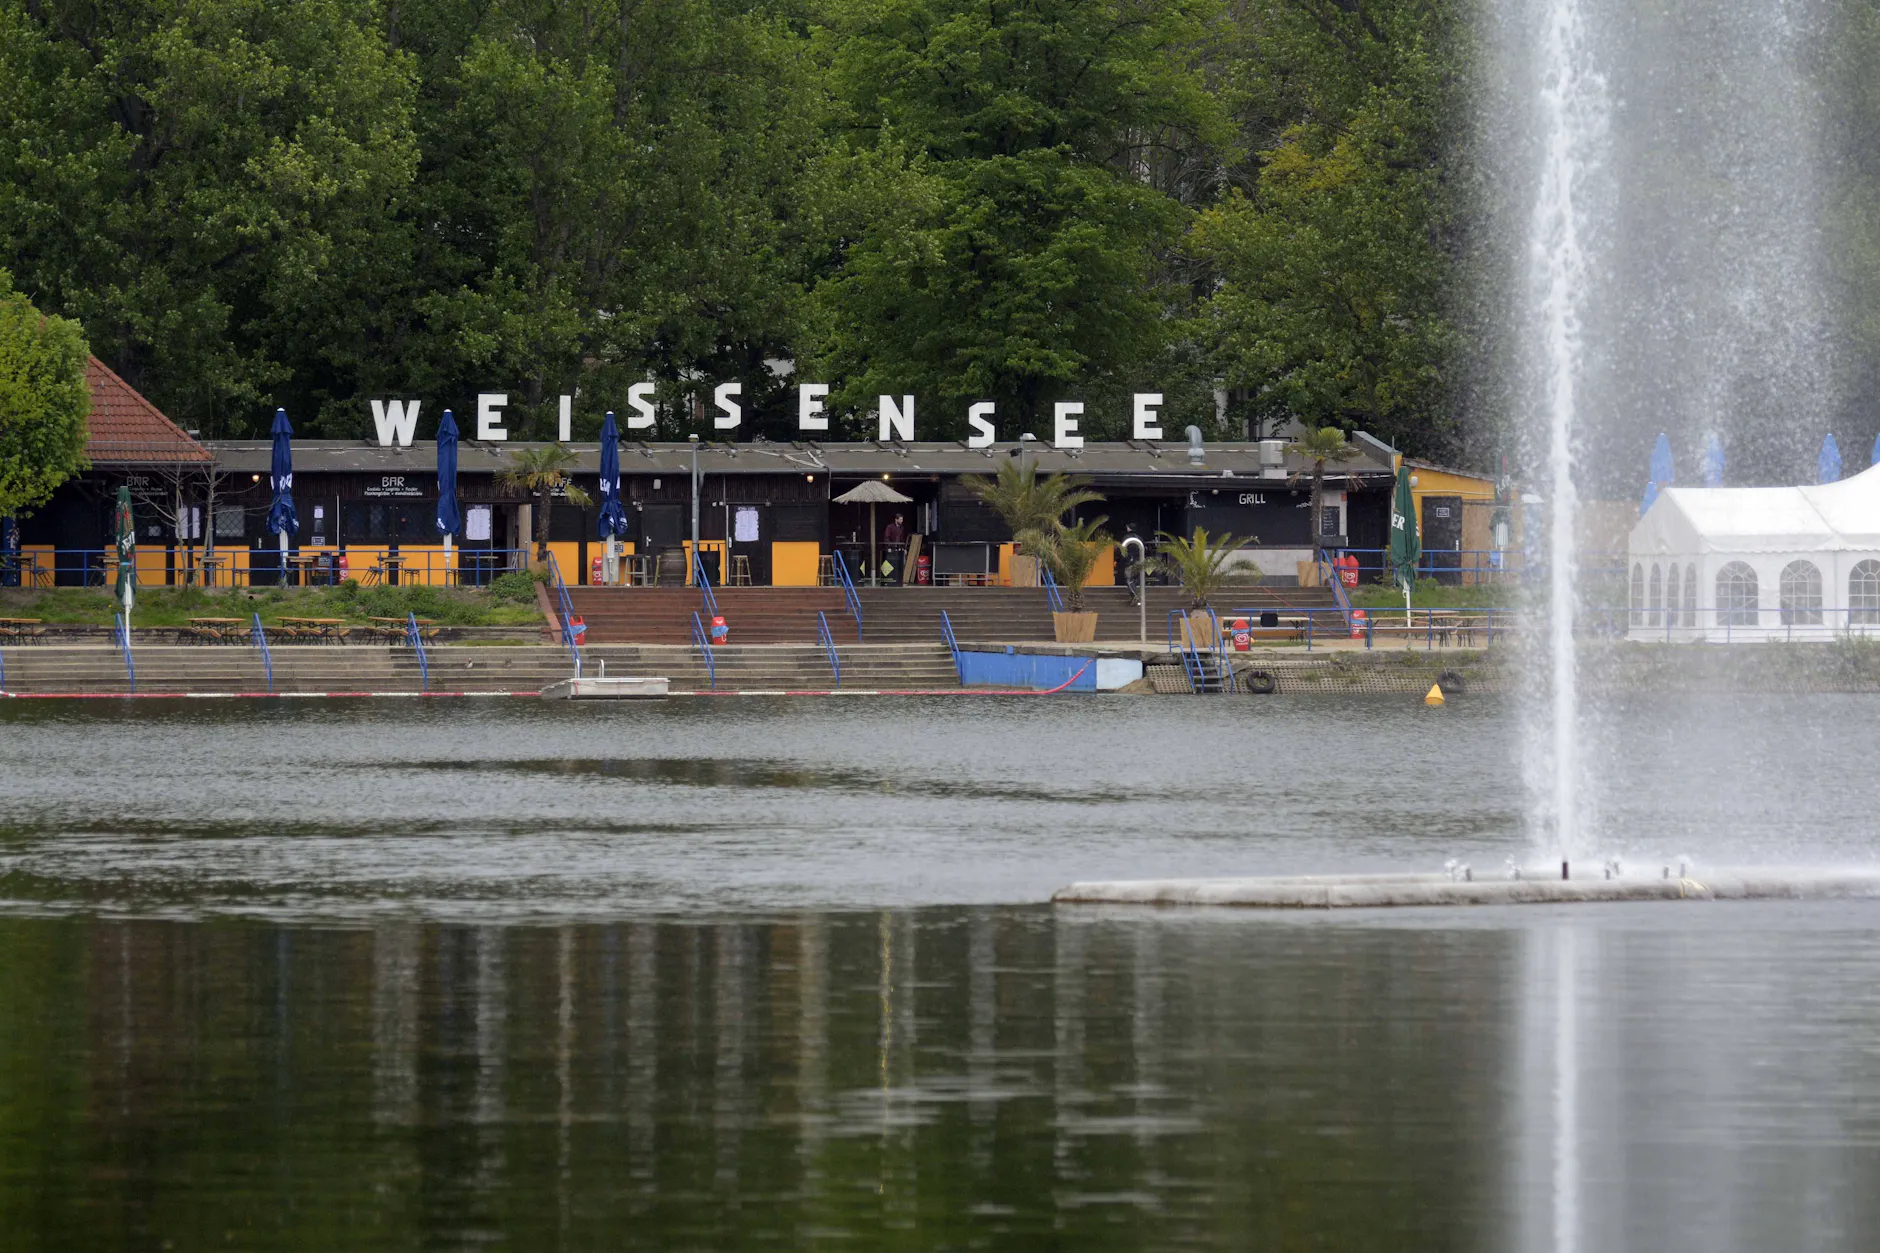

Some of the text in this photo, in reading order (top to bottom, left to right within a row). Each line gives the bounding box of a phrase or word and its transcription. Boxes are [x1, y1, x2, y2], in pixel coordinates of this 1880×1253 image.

[370, 382, 1163, 449] WEISSENSEE
[126, 476, 150, 487] BAR
[381, 476, 405, 487] BAR
[1238, 493, 1266, 505] GRILL
